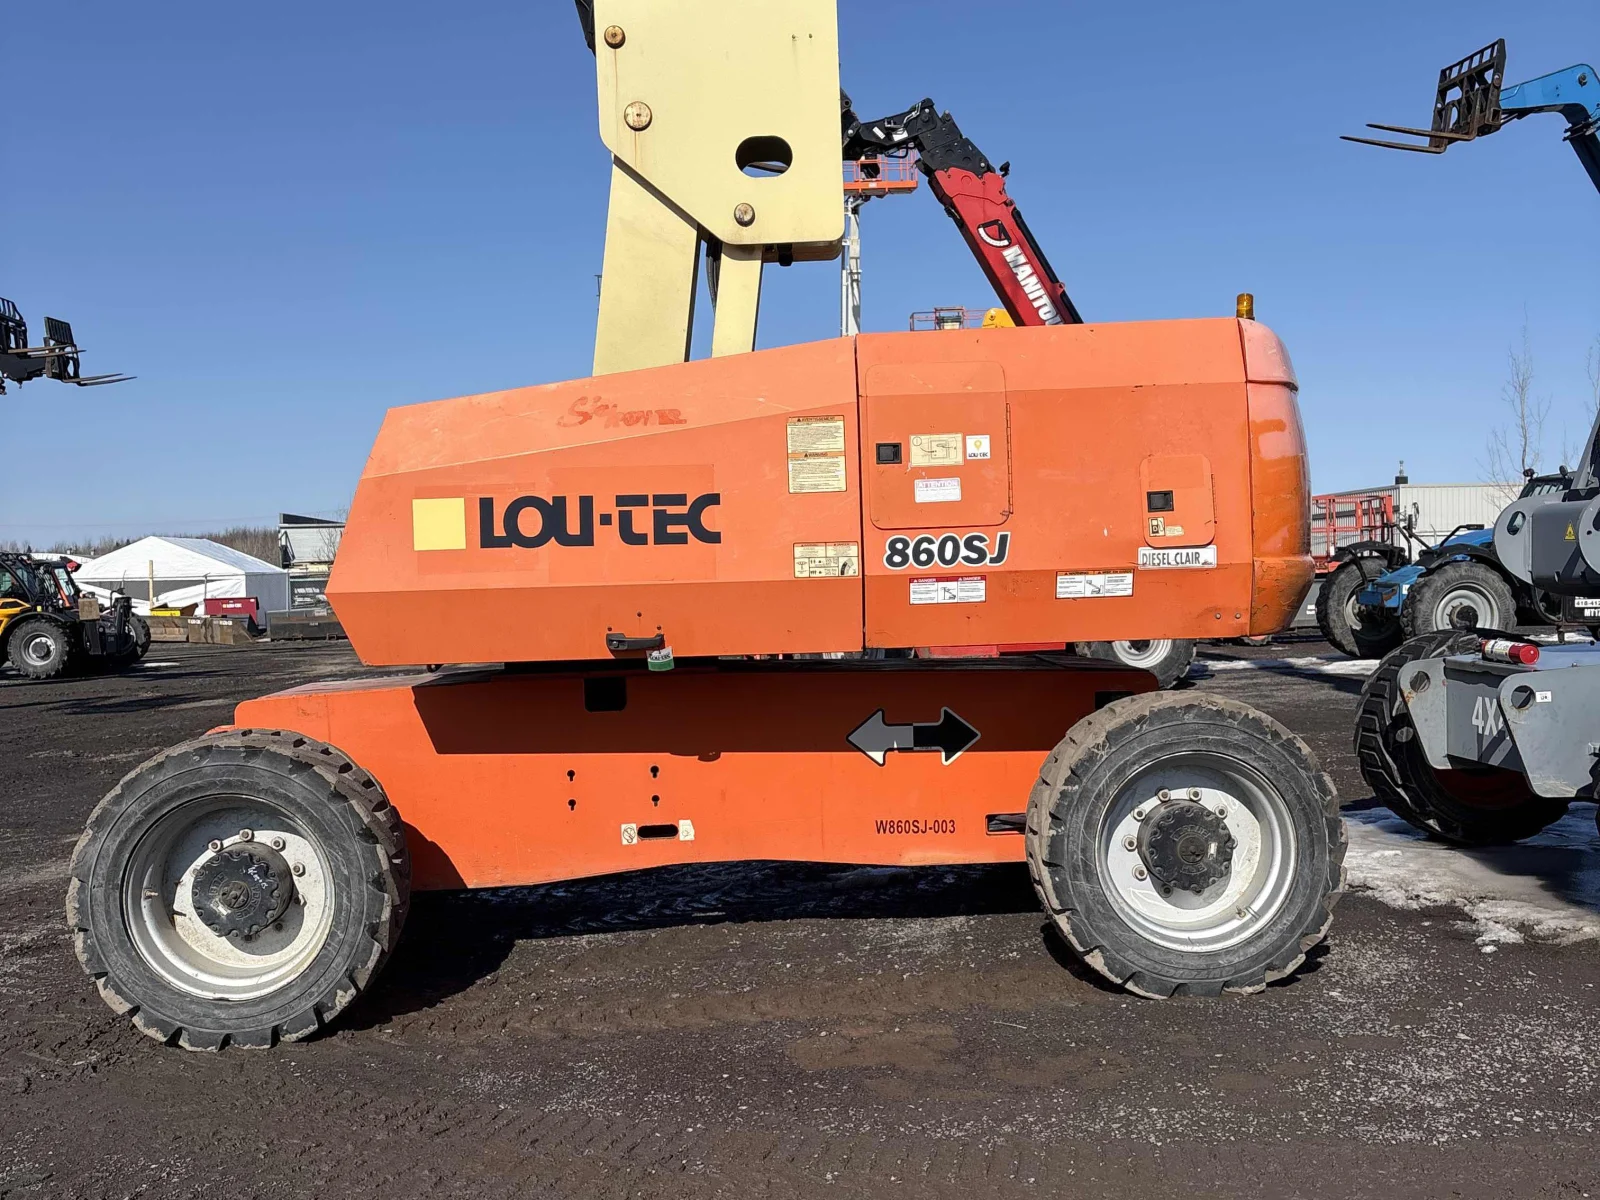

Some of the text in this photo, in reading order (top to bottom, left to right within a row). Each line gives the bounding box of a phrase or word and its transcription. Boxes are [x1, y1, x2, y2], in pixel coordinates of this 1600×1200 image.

[918, 480, 957, 488] ATTENTION
[479, 493, 721, 548] LOU-TEC
[884, 532, 1010, 569] 860SJ
[1142, 552, 1171, 566] DIESEL
[1174, 551, 1200, 565] CLAIR
[875, 819, 956, 834] W860SJ-003
